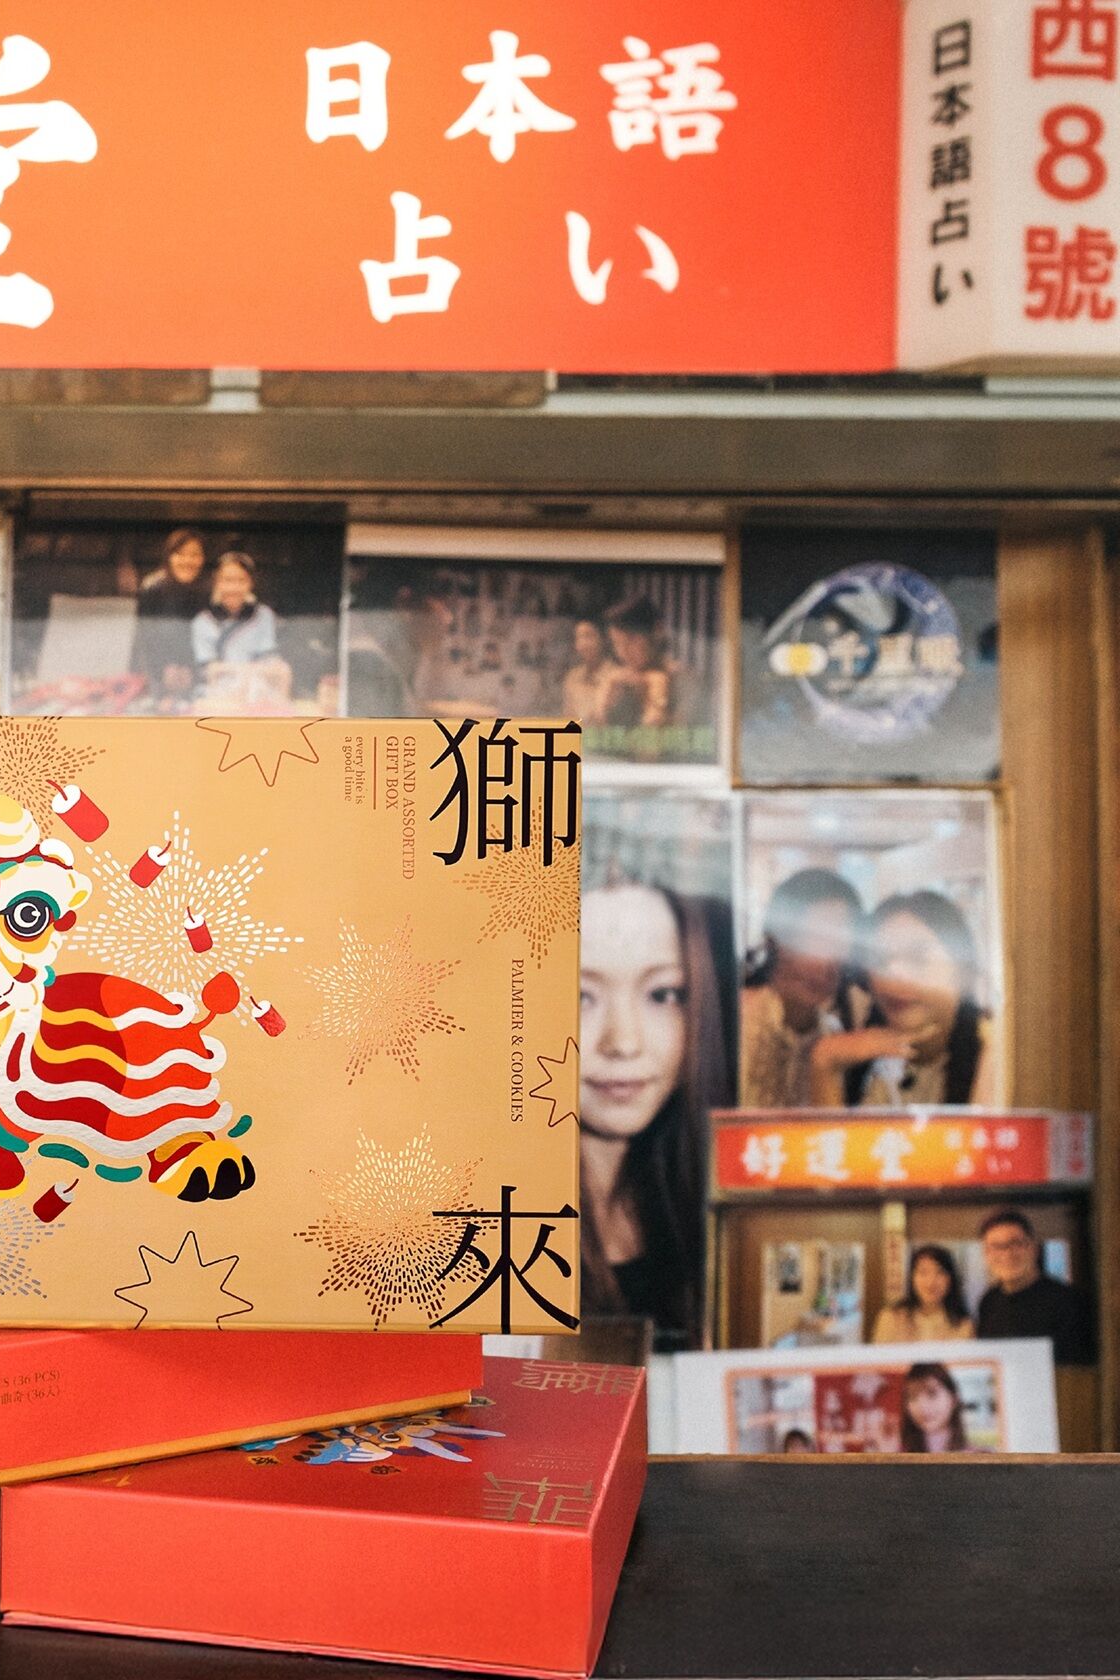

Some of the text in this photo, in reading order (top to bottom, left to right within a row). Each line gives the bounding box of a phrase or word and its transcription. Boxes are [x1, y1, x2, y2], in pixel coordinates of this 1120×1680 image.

[305, 30, 737, 163] 日本語
[929, 18, 974, 307] 日本語占い
[1024, 0, 1117, 321] 西8號
[360, 191, 679, 323] 占い
[342, 745, 355, 773] good
[344, 776, 355, 802] time
[353, 736, 363, 765] every
[355, 770, 366, 791] bite
[385, 736, 399, 809] GIFT BOX
[402, 736, 416, 880] GRAND ASSORTED
[430, 719, 582, 867] 獅
[510, 958, 525, 1122] PALMIER & COOKIES
[429, 1185, 580, 1334] 來
[13, 1375, 31, 1386] (36
[34, 1370, 61, 1383] PCS)
